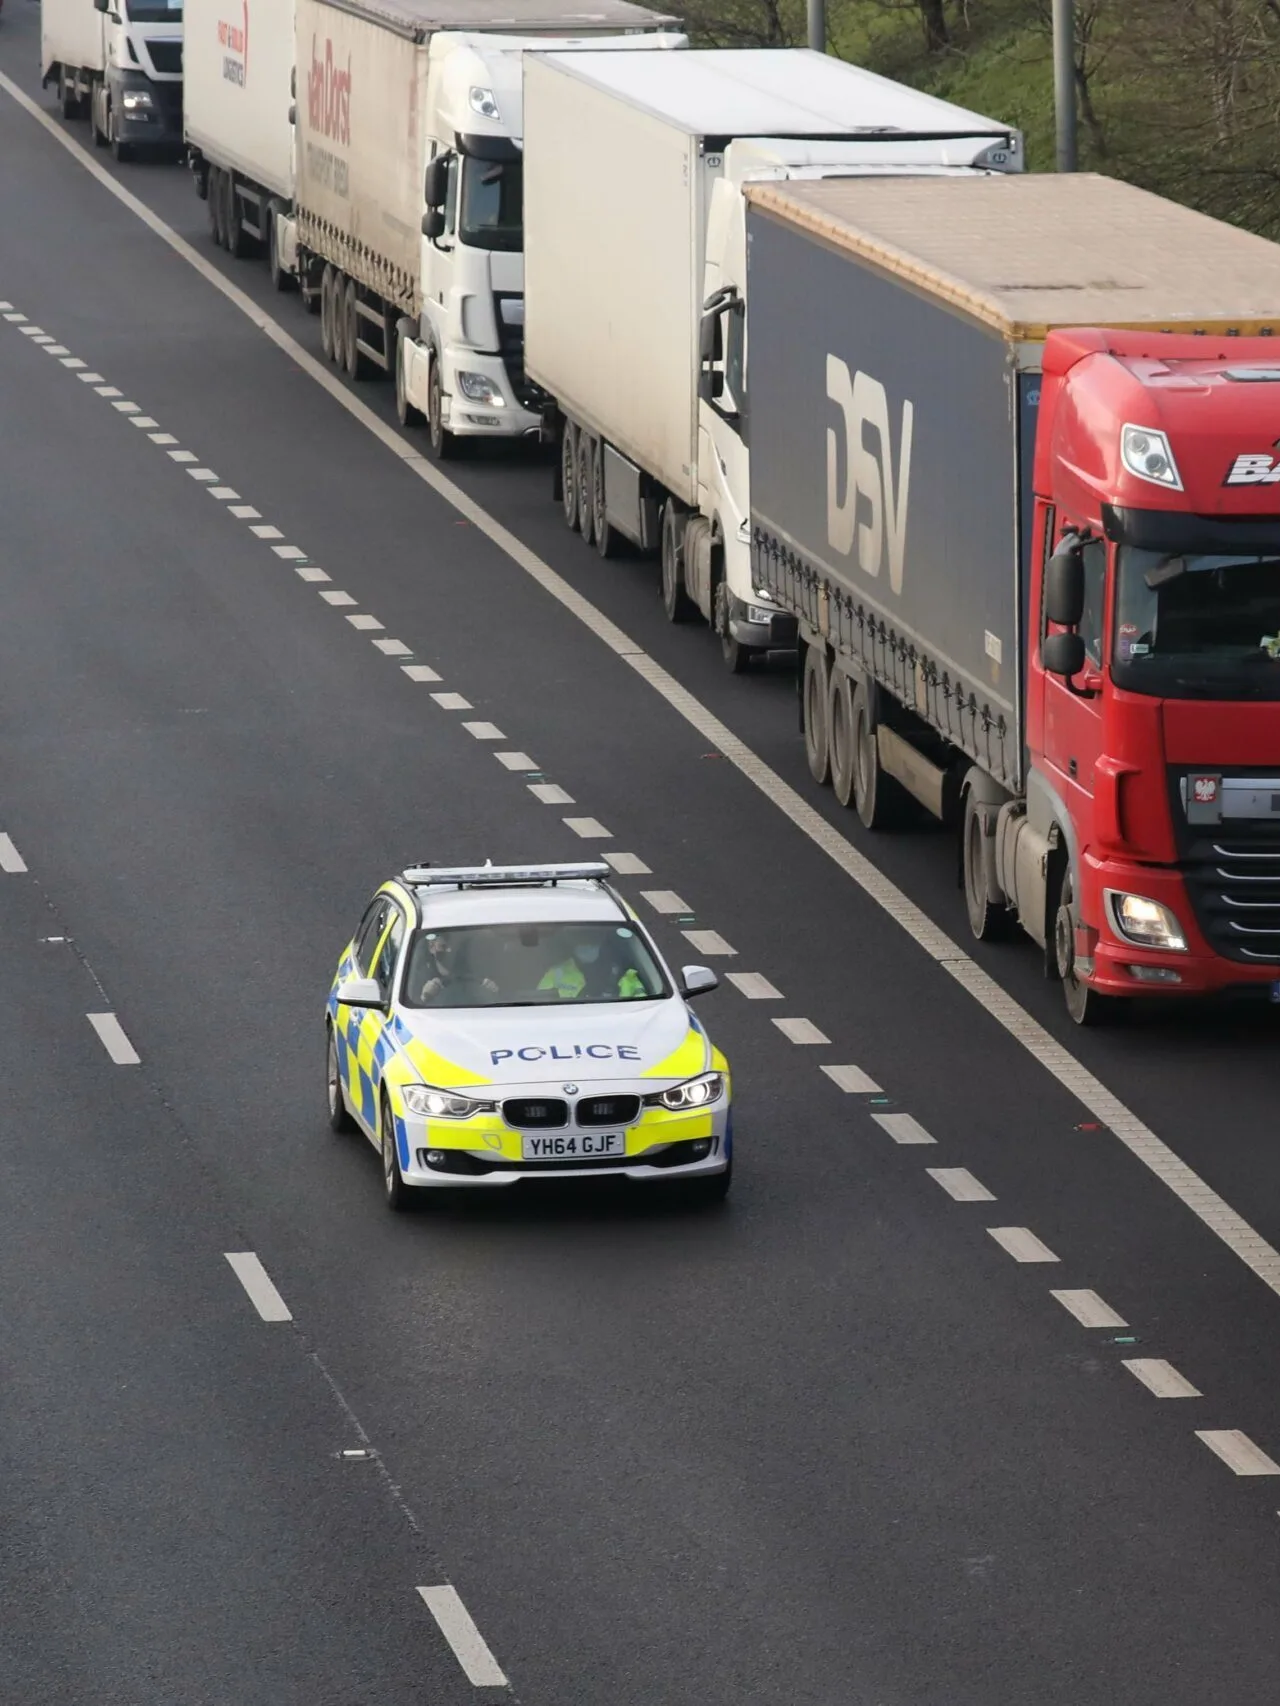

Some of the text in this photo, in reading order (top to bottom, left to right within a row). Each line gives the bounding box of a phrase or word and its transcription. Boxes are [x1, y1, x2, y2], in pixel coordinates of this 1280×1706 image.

[826, 352, 914, 596] DSV
[490, 1044, 642, 1066] POLICE
[530, 1135, 616, 1155] YH64 GJF
